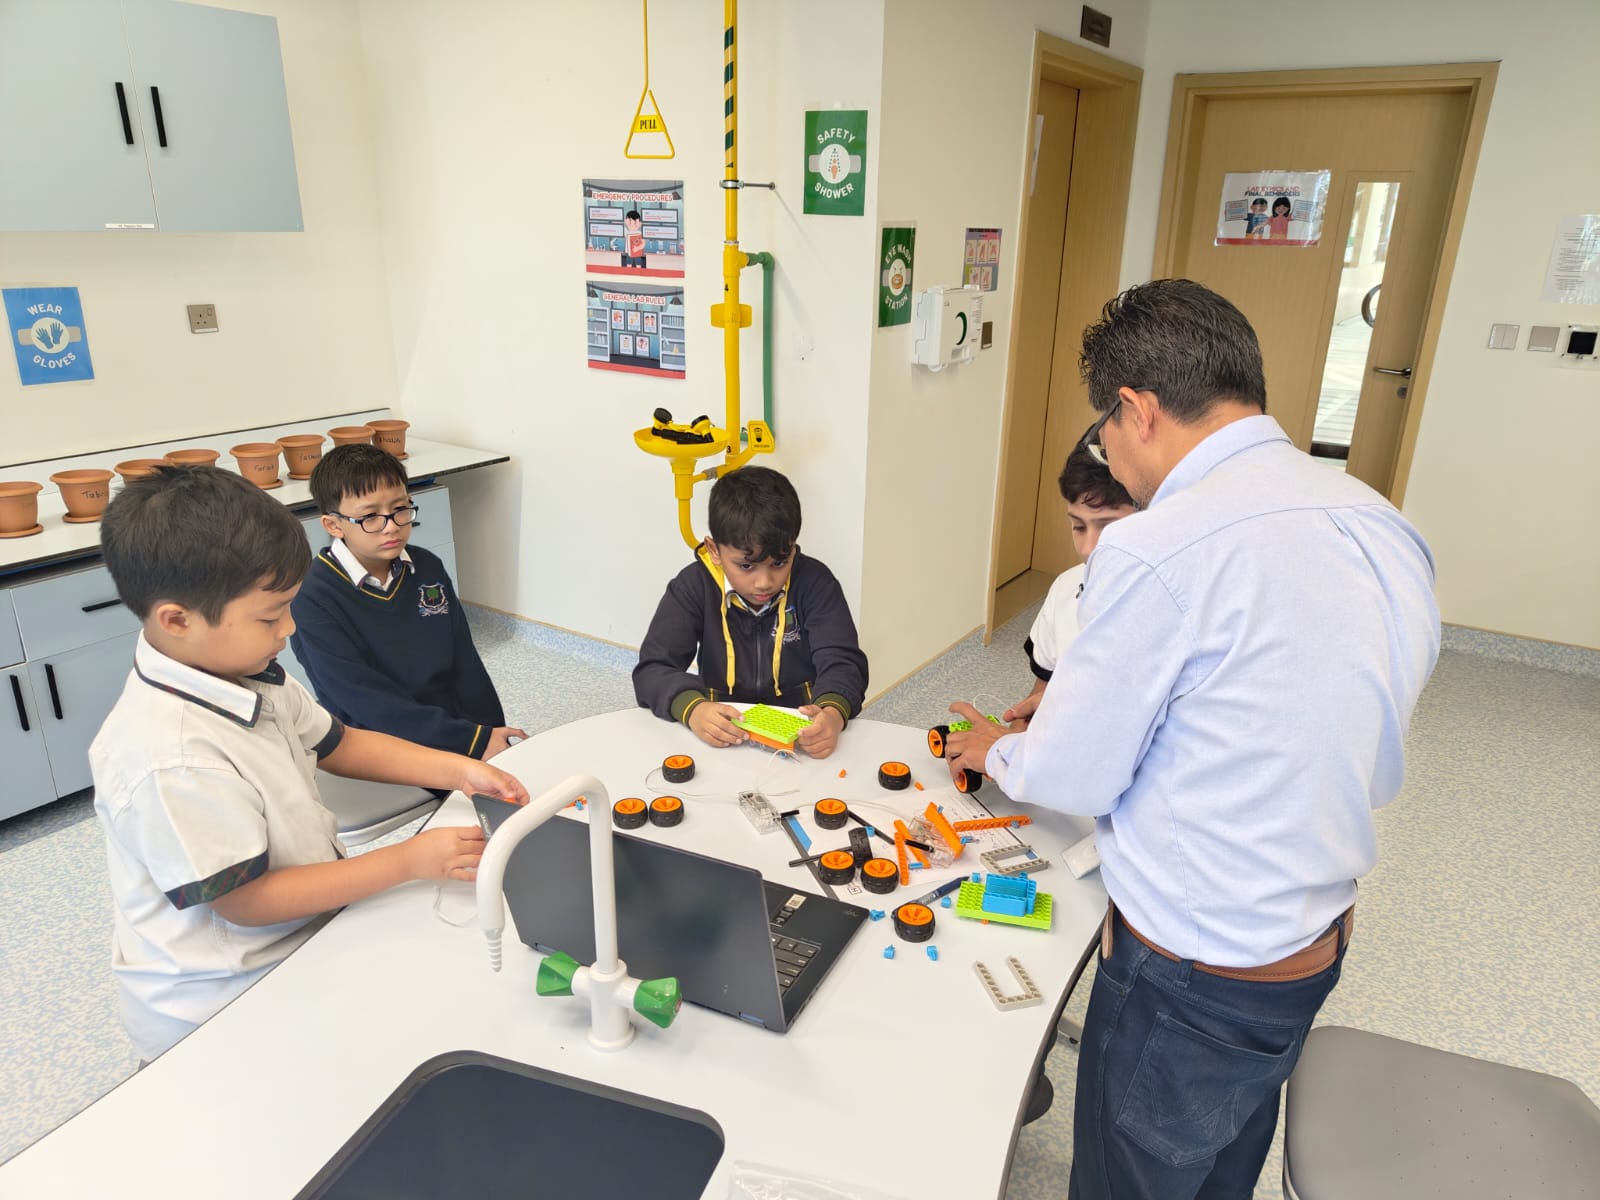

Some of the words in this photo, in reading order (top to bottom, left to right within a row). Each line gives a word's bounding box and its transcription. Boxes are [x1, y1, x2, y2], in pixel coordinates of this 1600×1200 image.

[640, 119, 657, 130] PULL
[817, 127, 856, 144] SAFETY
[592, 192, 630, 200] EMERGENCY
[631, 193, 673, 201] PROCEDURES
[814, 182, 855, 200] SHOWER
[885, 246, 897, 265] EYE
[603, 293, 630, 302] GENERAL
[632, 295, 645, 303] LAB
[646, 296, 665, 305] RULES
[884, 294, 908, 310] STATION
[27, 303, 63, 316] WEAR
[32, 352, 77, 369] GLOVES
